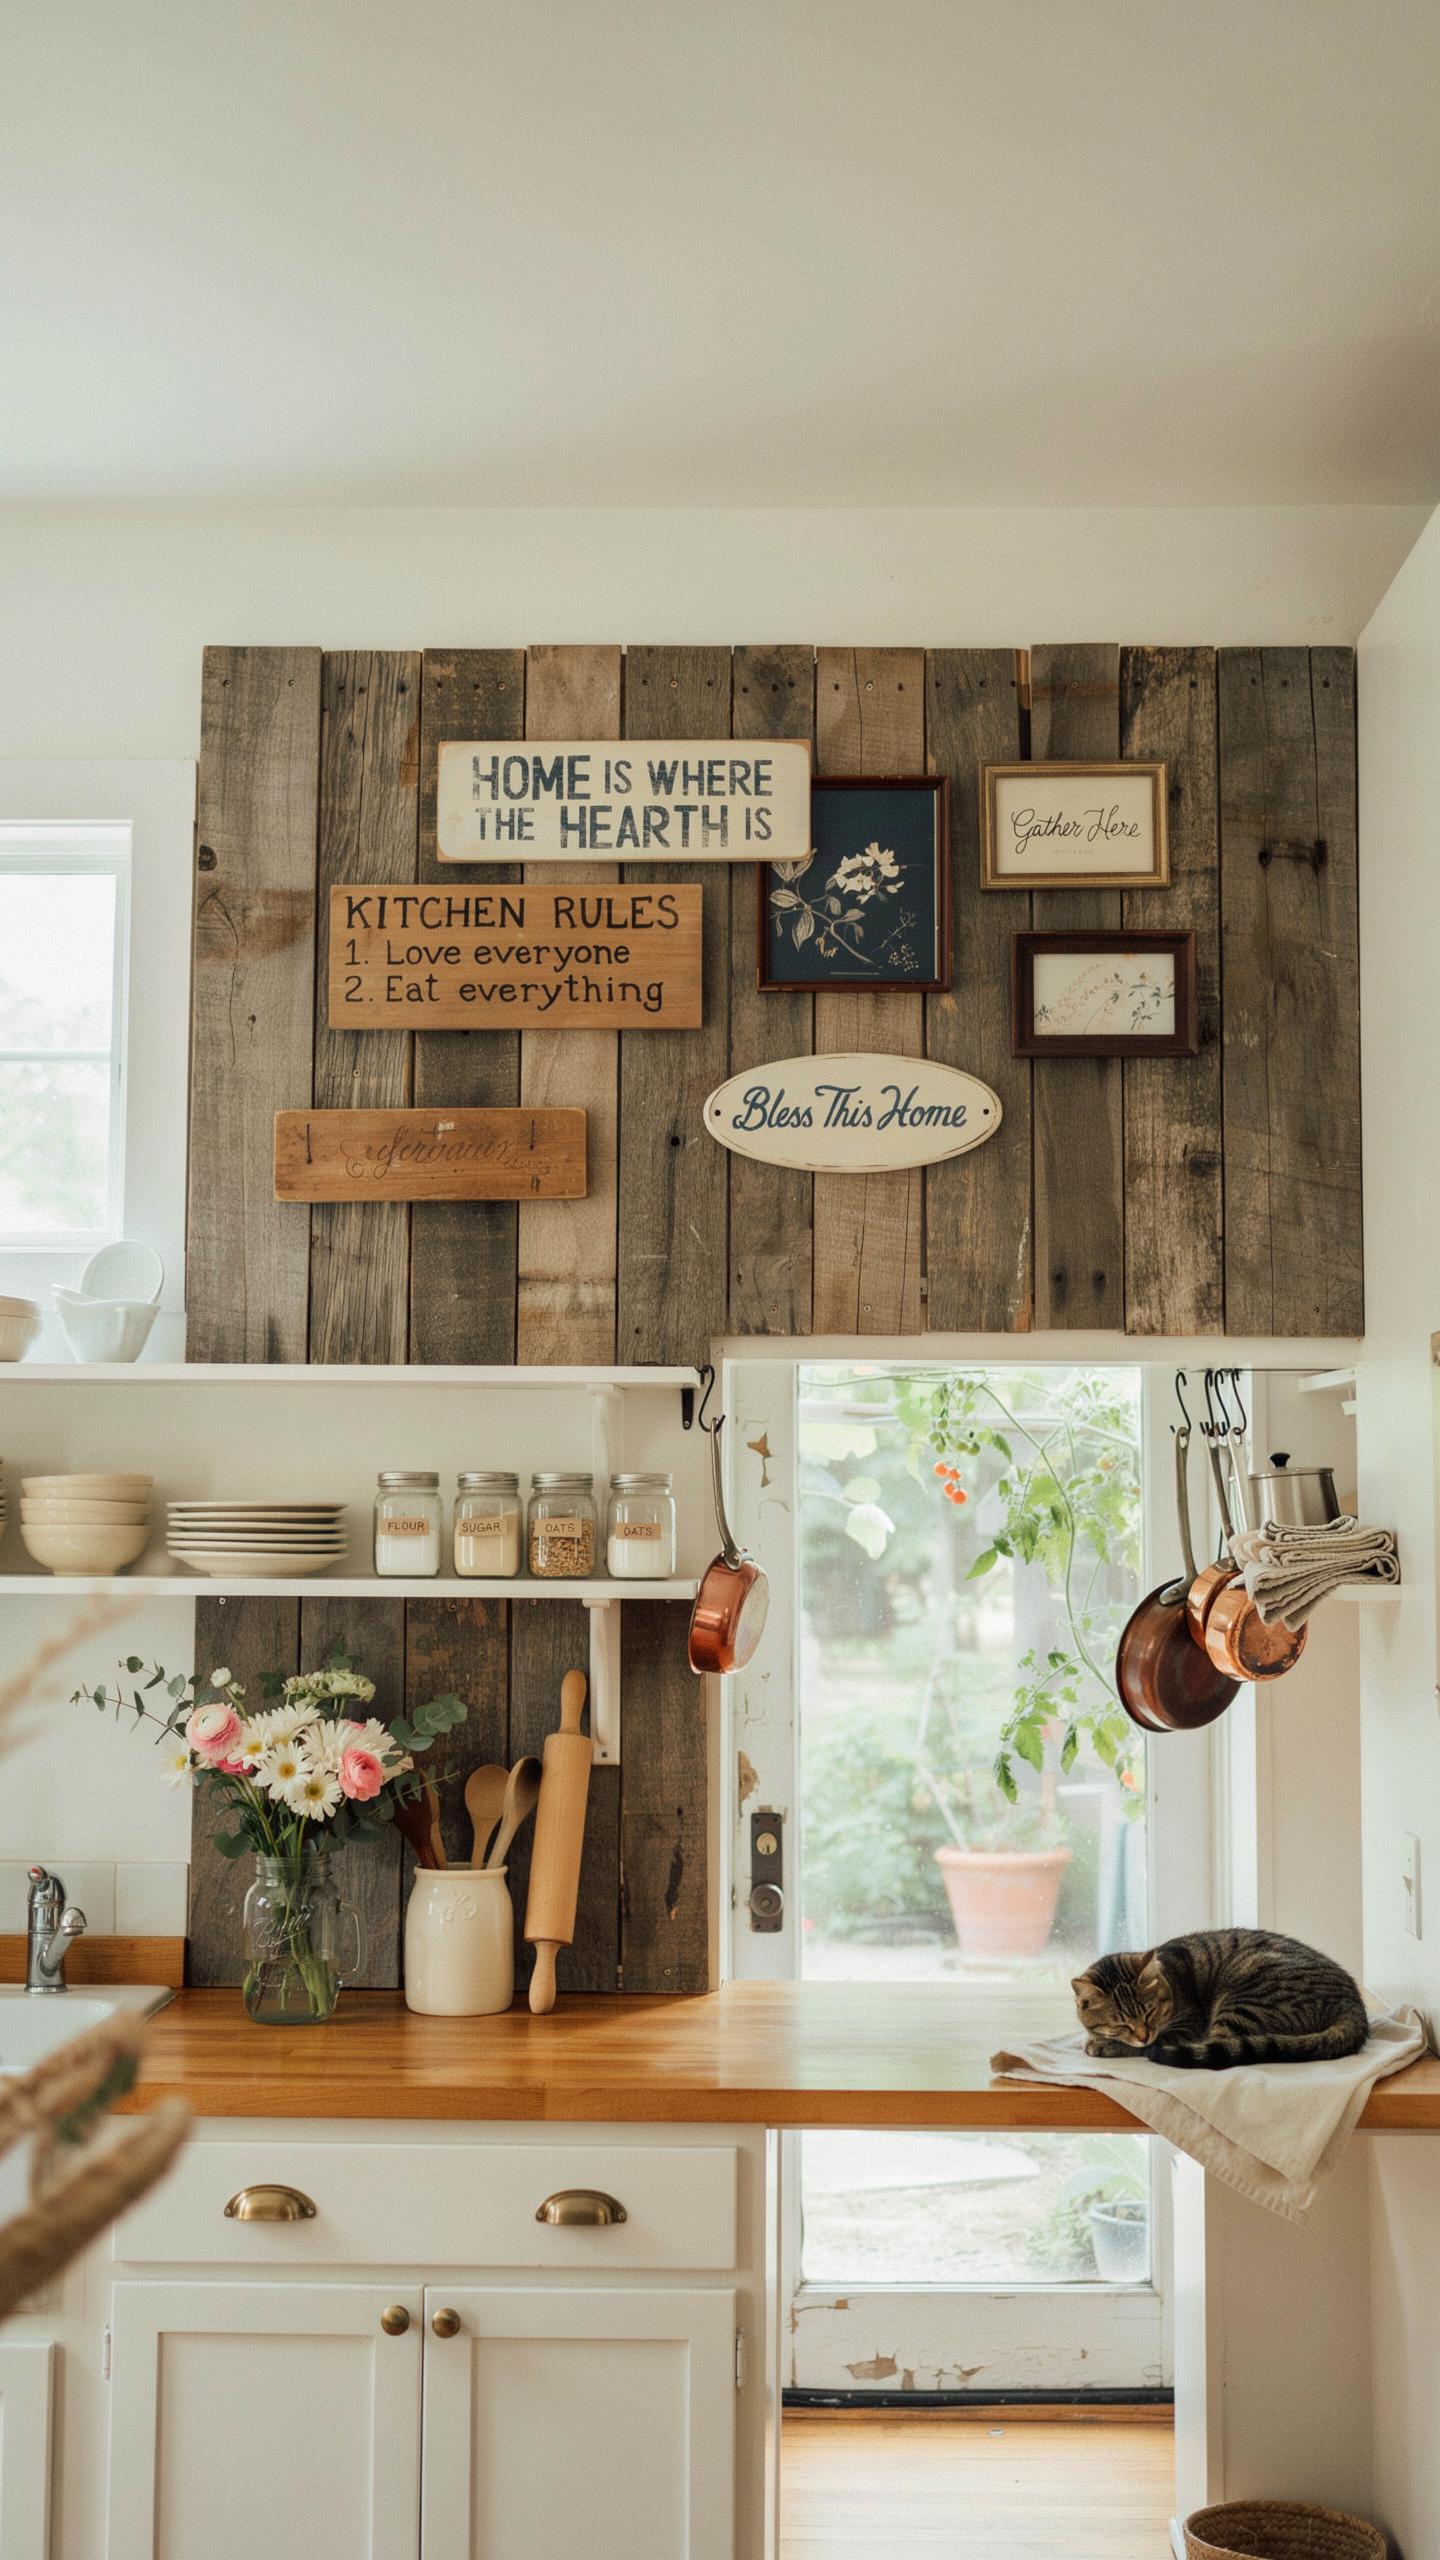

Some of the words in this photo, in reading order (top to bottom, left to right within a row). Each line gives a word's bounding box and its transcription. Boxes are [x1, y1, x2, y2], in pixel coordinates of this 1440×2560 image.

[471, 754, 591, 801] HOME
[604, 759, 633, 794] IS
[646, 758, 774, 797] WHERE
[474, 806, 535, 841] THE
[559, 804, 729, 849] HEARTH
[744, 806, 773, 841] IS
[1010, 807, 1083, 855] Gather
[1082, 804, 1142, 843] Here
[344, 896, 526, 930] KITCHEN
[553, 894, 680, 930] RULES
[344, 938, 369, 966] 1.
[385, 939, 461, 966] Love
[473, 943, 631, 973] everyone
[344, 975, 374, 1003] 2.
[385, 973, 441, 1003] Eat
[458, 973, 664, 1013] everything
[731, 1085, 814, 1132] Bless
[814, 1084, 873, 1128] This
[876, 1084, 968, 1131] Home
[387, 1520, 425, 1531] FLOUR
[461, 1521, 501, 1533] SUGAR
[623, 1526, 653, 1537] OATS
